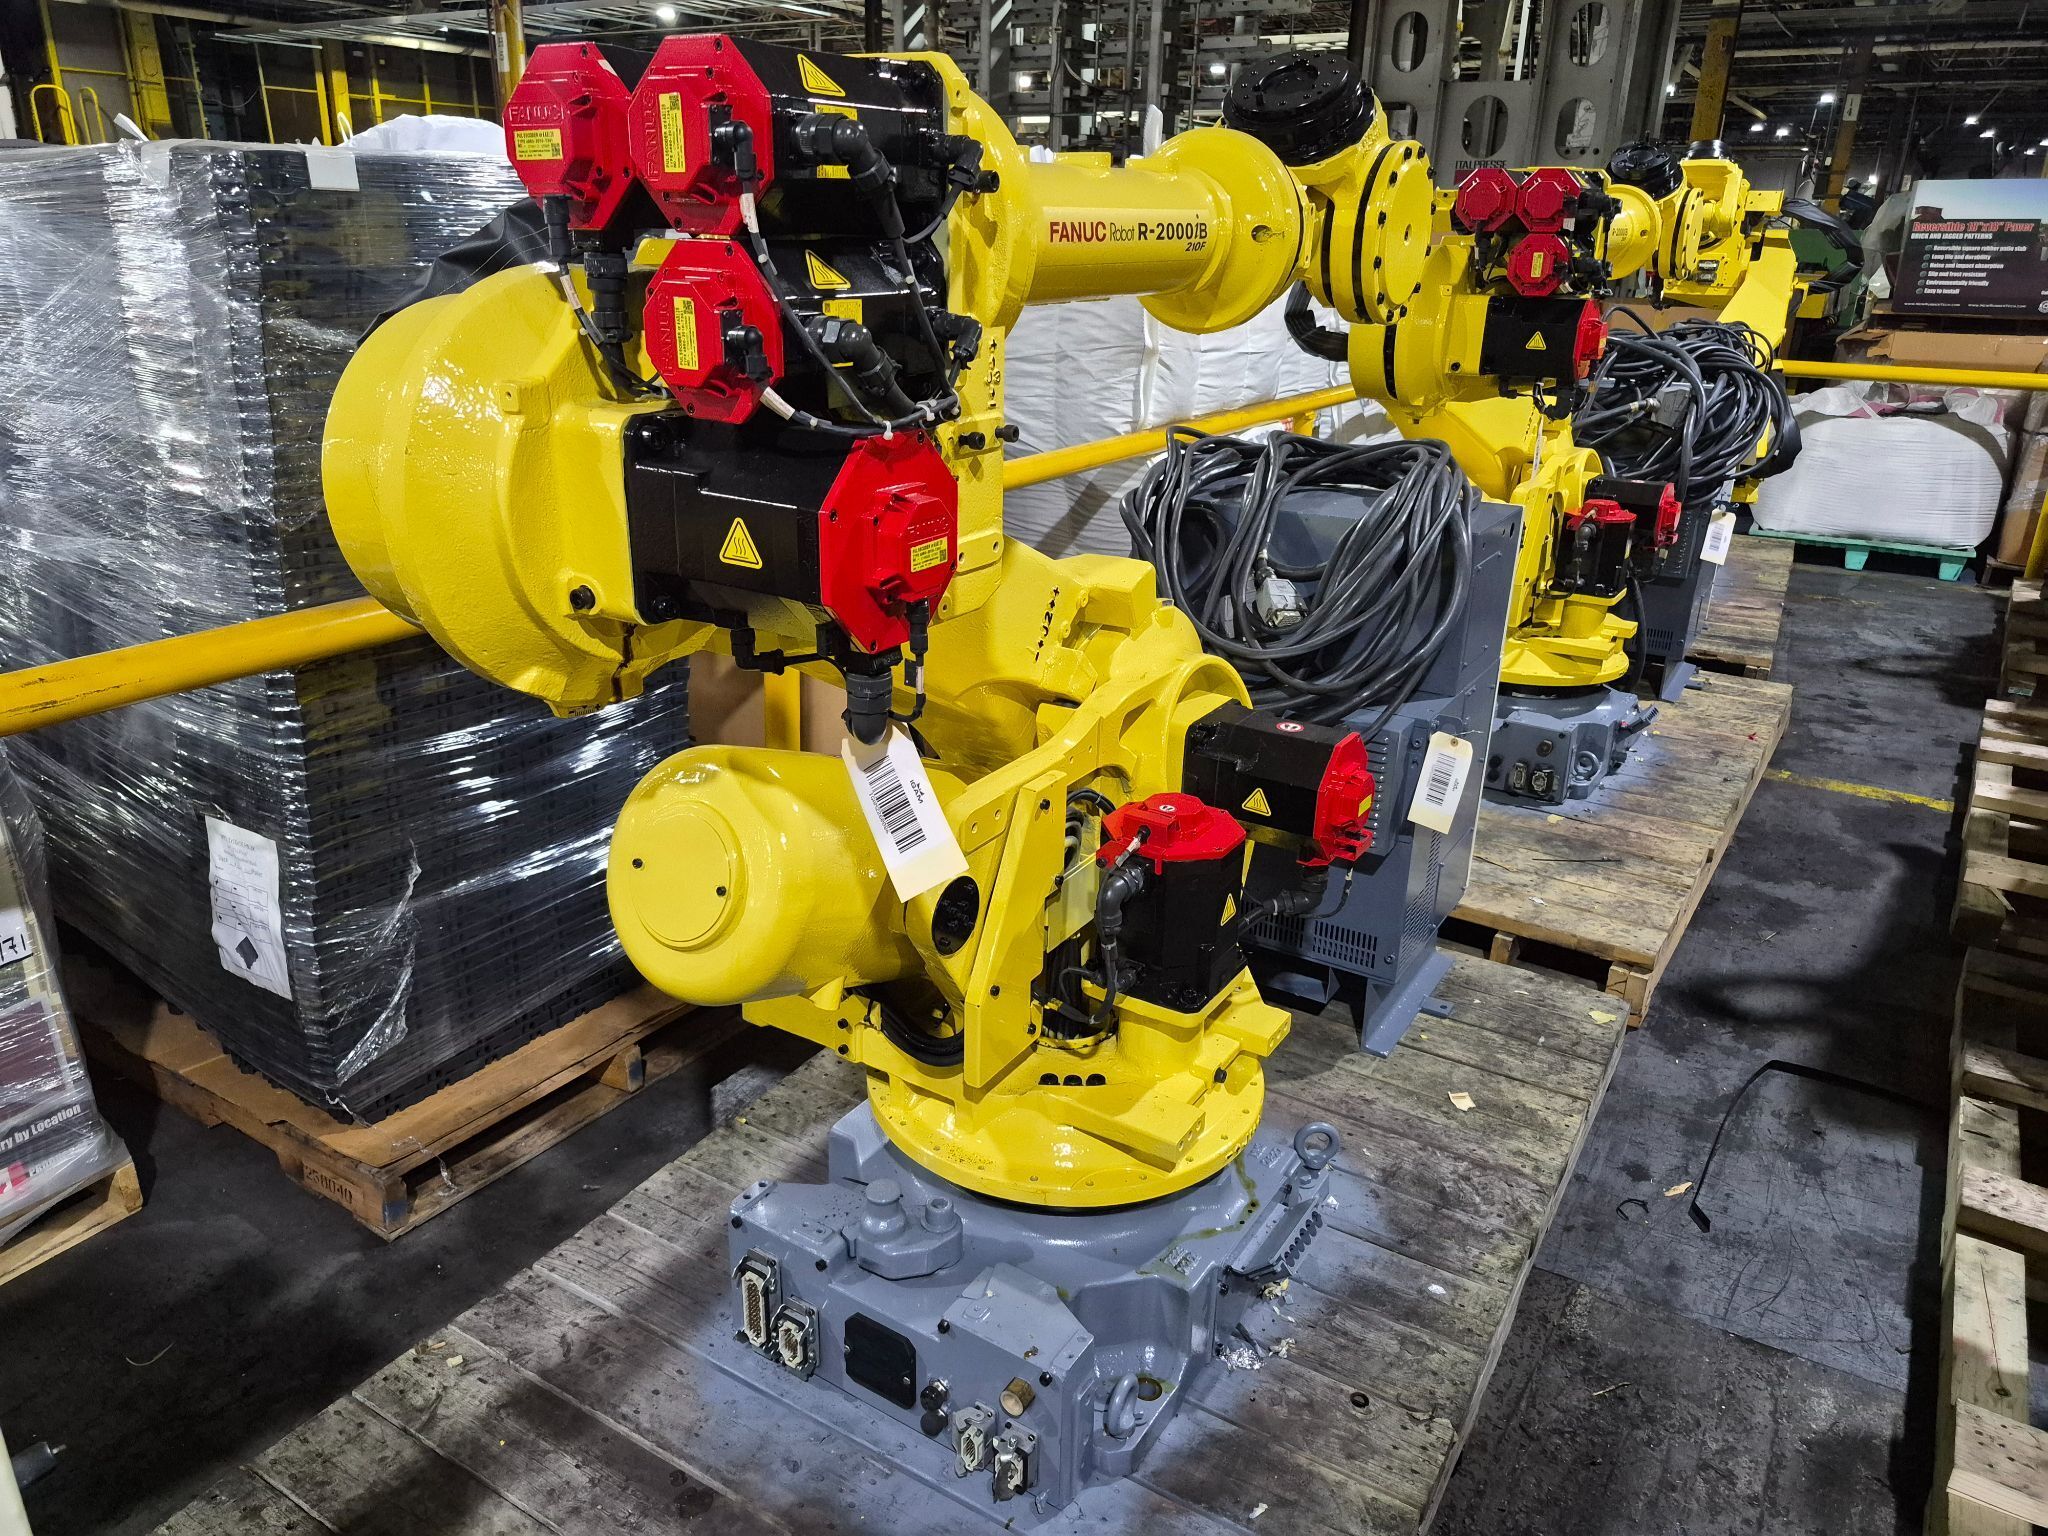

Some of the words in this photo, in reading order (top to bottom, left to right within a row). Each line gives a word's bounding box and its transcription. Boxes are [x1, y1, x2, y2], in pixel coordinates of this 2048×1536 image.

[1050, 221, 1107, 243] FANUC
[1109, 222, 1135, 242] Robot
[1912, 222, 1966, 232] Reversible
[2004, 222, 2034, 232] Paver
[1185, 242, 1206, 252] 210F
[14, 1128, 31, 1144] by
[30, 1103, 82, 1136] Location
